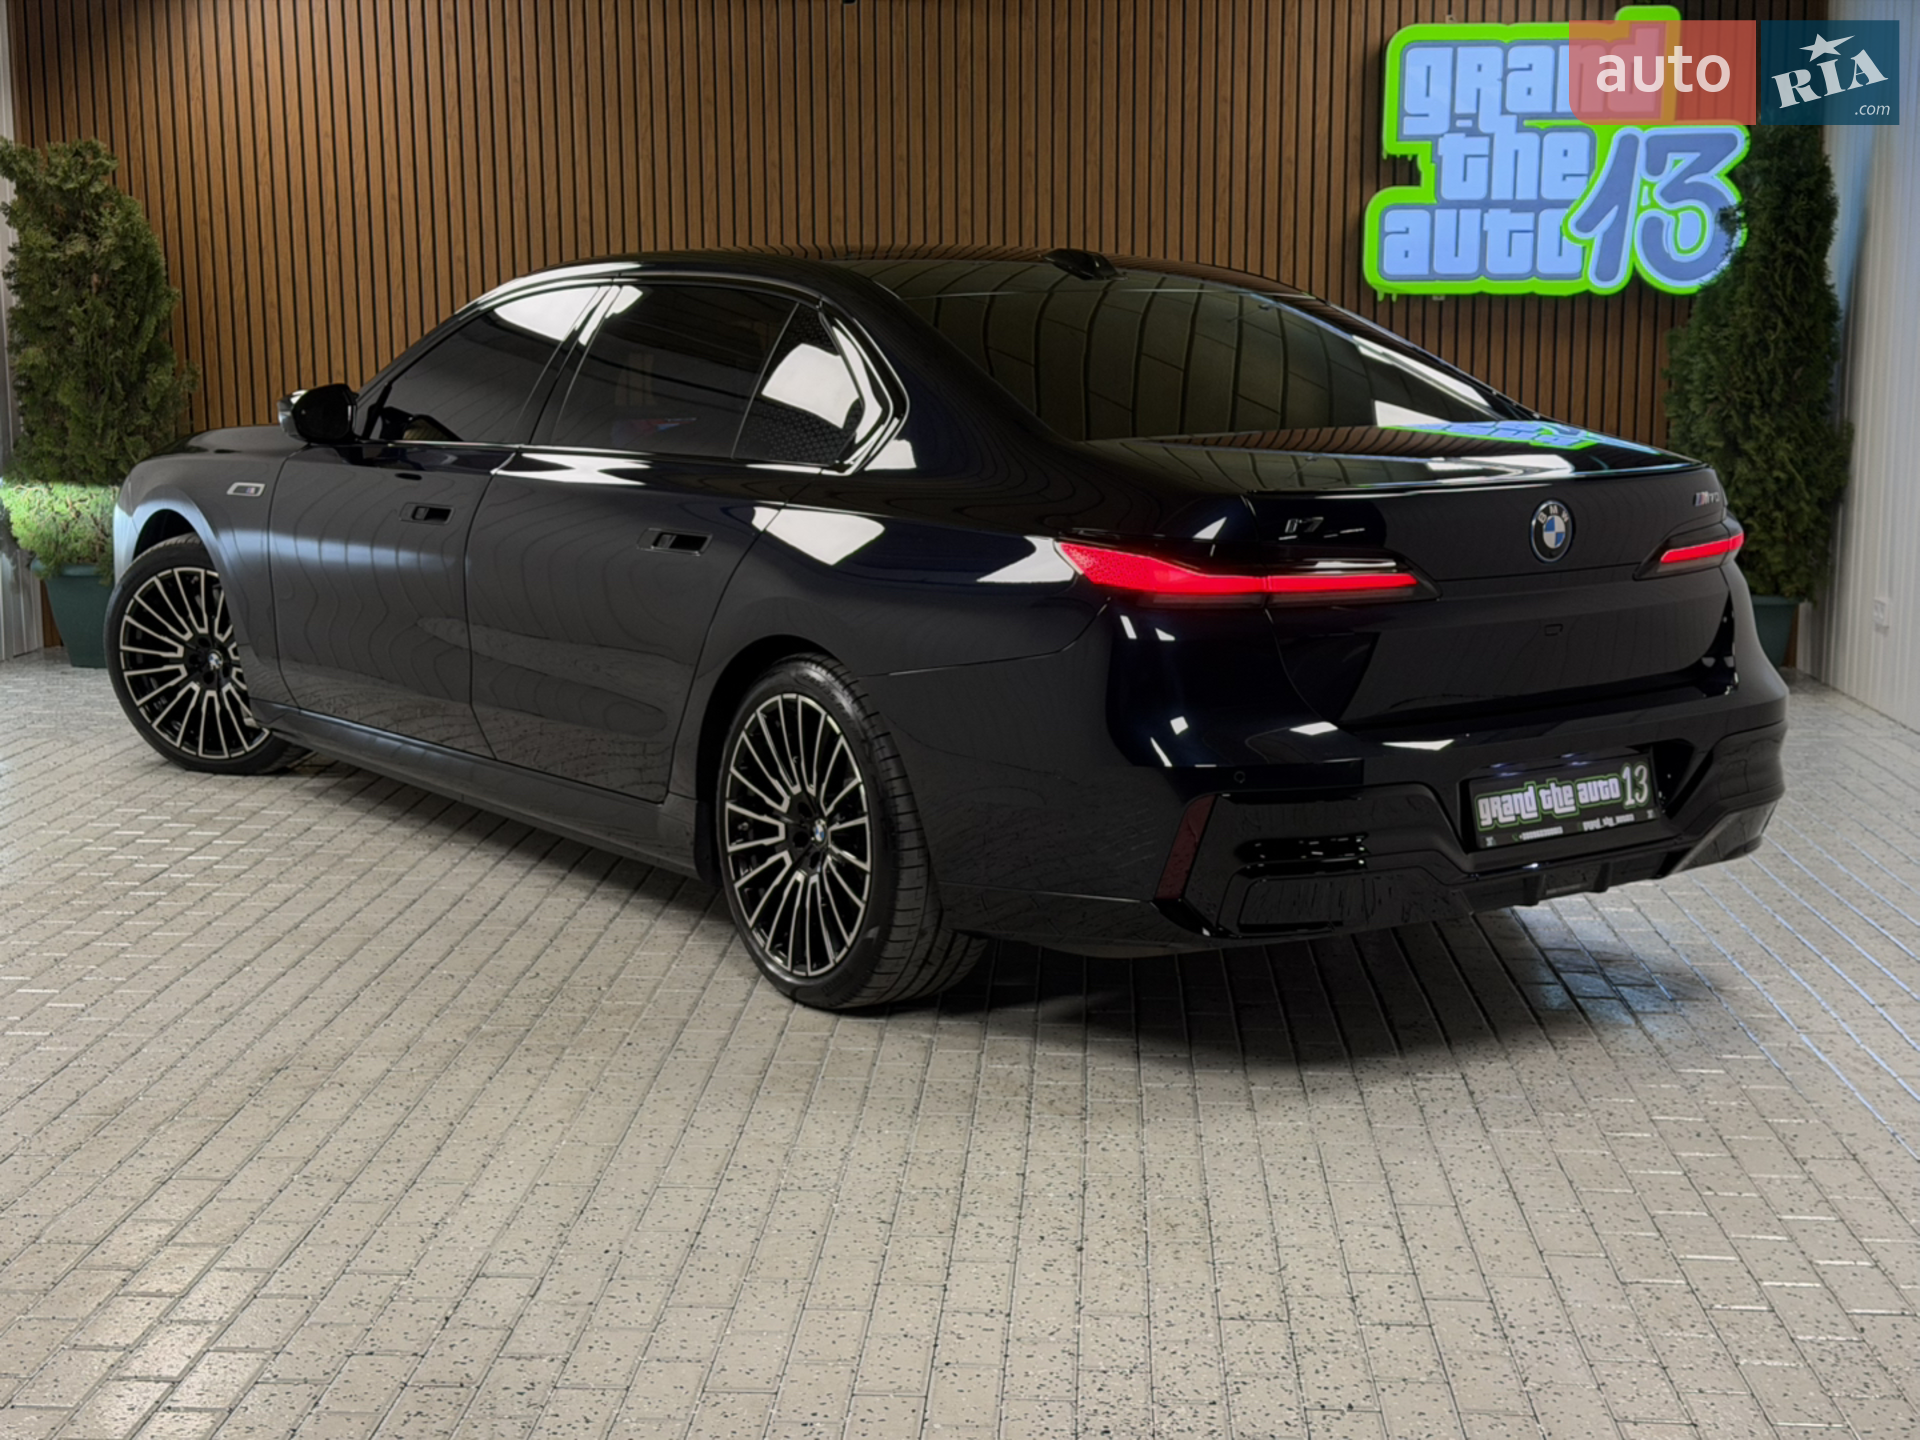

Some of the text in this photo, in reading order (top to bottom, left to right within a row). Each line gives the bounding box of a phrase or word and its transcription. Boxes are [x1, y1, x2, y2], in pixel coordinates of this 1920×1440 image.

[1437, 115, 1592, 200] the
[1383, 127, 1747, 288] auto 13
[1536, 503, 1570, 524] BMW
[1538, 782, 1577, 815] the
[1576, 777, 1622, 804] auto
[1622, 764, 1649, 807] 13
